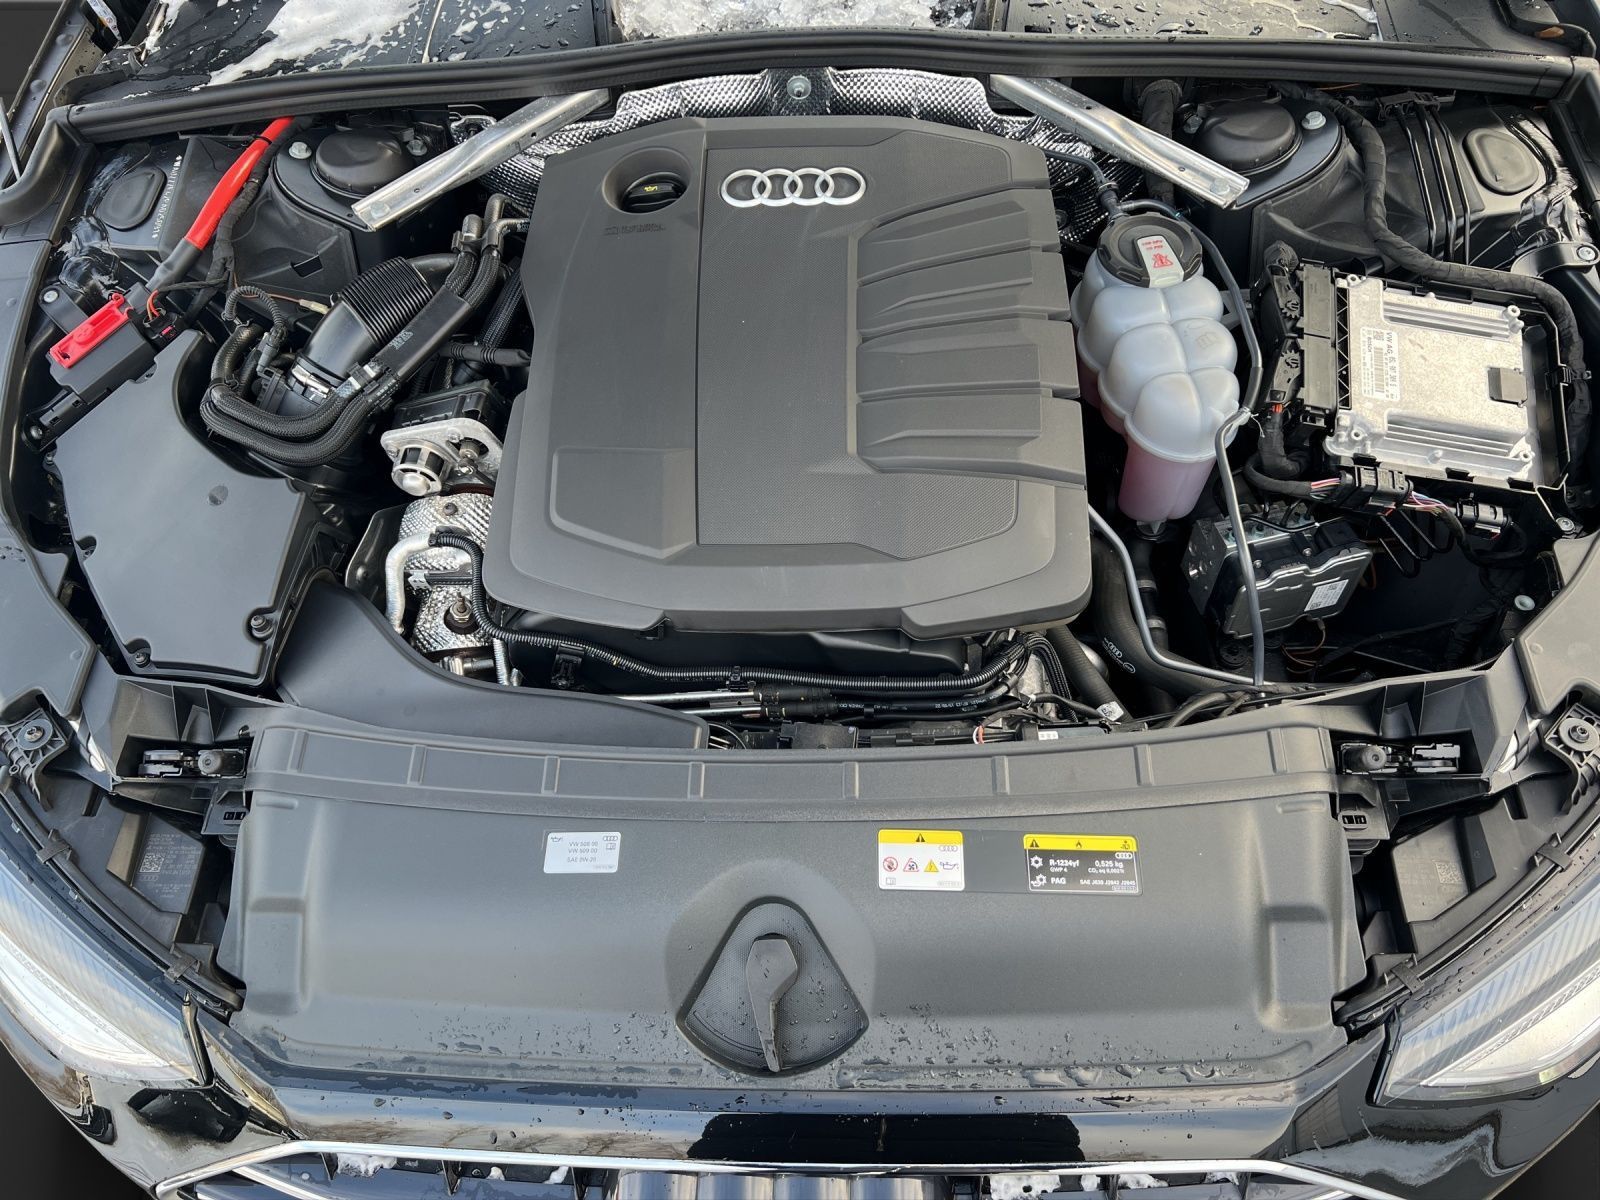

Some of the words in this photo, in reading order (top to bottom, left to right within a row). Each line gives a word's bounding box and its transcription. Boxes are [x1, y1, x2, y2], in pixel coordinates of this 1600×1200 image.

[1049, 859, 1080, 867] R-1234yf
[1095, 860, 1114, 868] 0,525
[1114, 861, 1124, 869] kg
[1051, 877, 1067, 885] PAG
